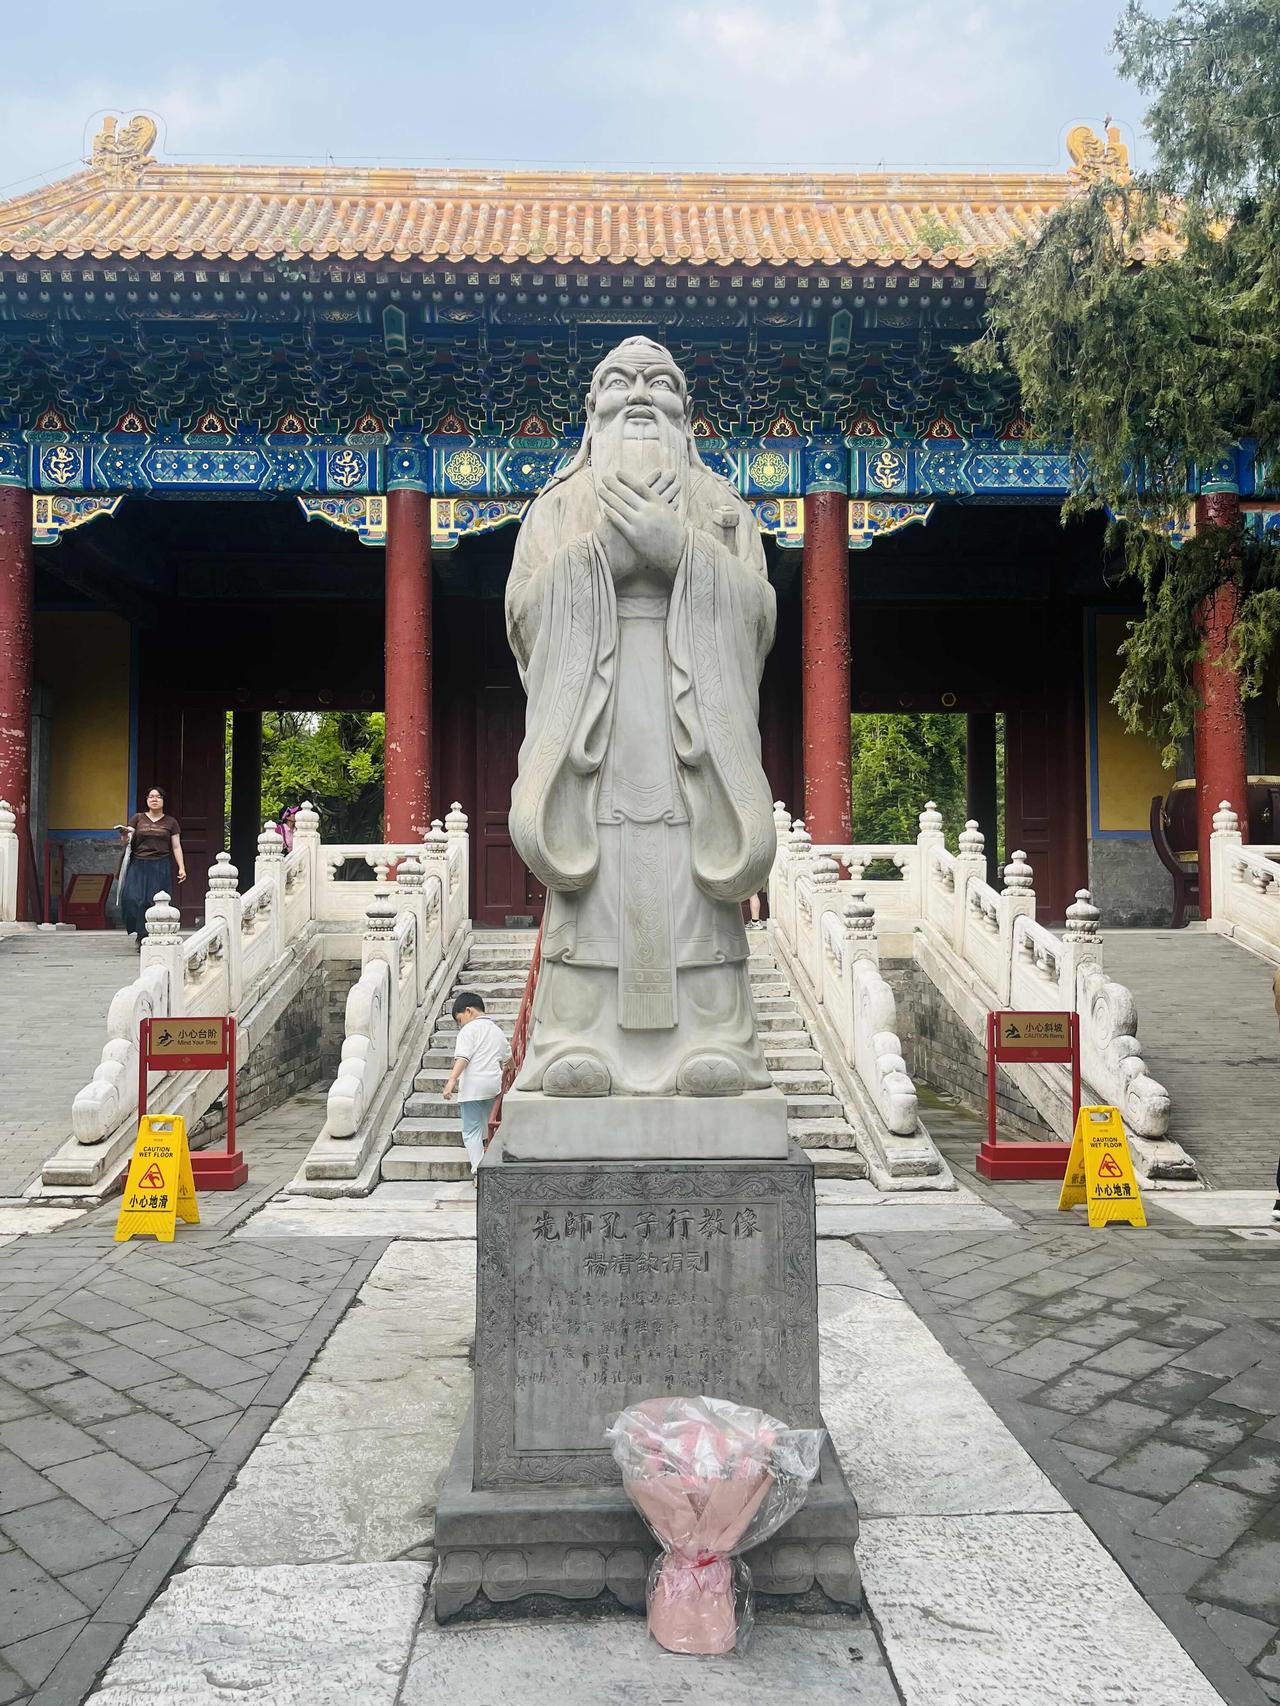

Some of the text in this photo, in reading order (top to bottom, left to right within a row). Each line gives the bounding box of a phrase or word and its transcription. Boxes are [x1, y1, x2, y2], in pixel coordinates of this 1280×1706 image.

[178, 1028, 218, 1039] 小心台阶
[1025, 1022, 1063, 1032] 小心斜坡
[1095, 1182, 1131, 1197] 小心地滑
[129, 1193, 169, 1209] 小心地滑
[532, 1207, 763, 1242] 先師孔子行教像
